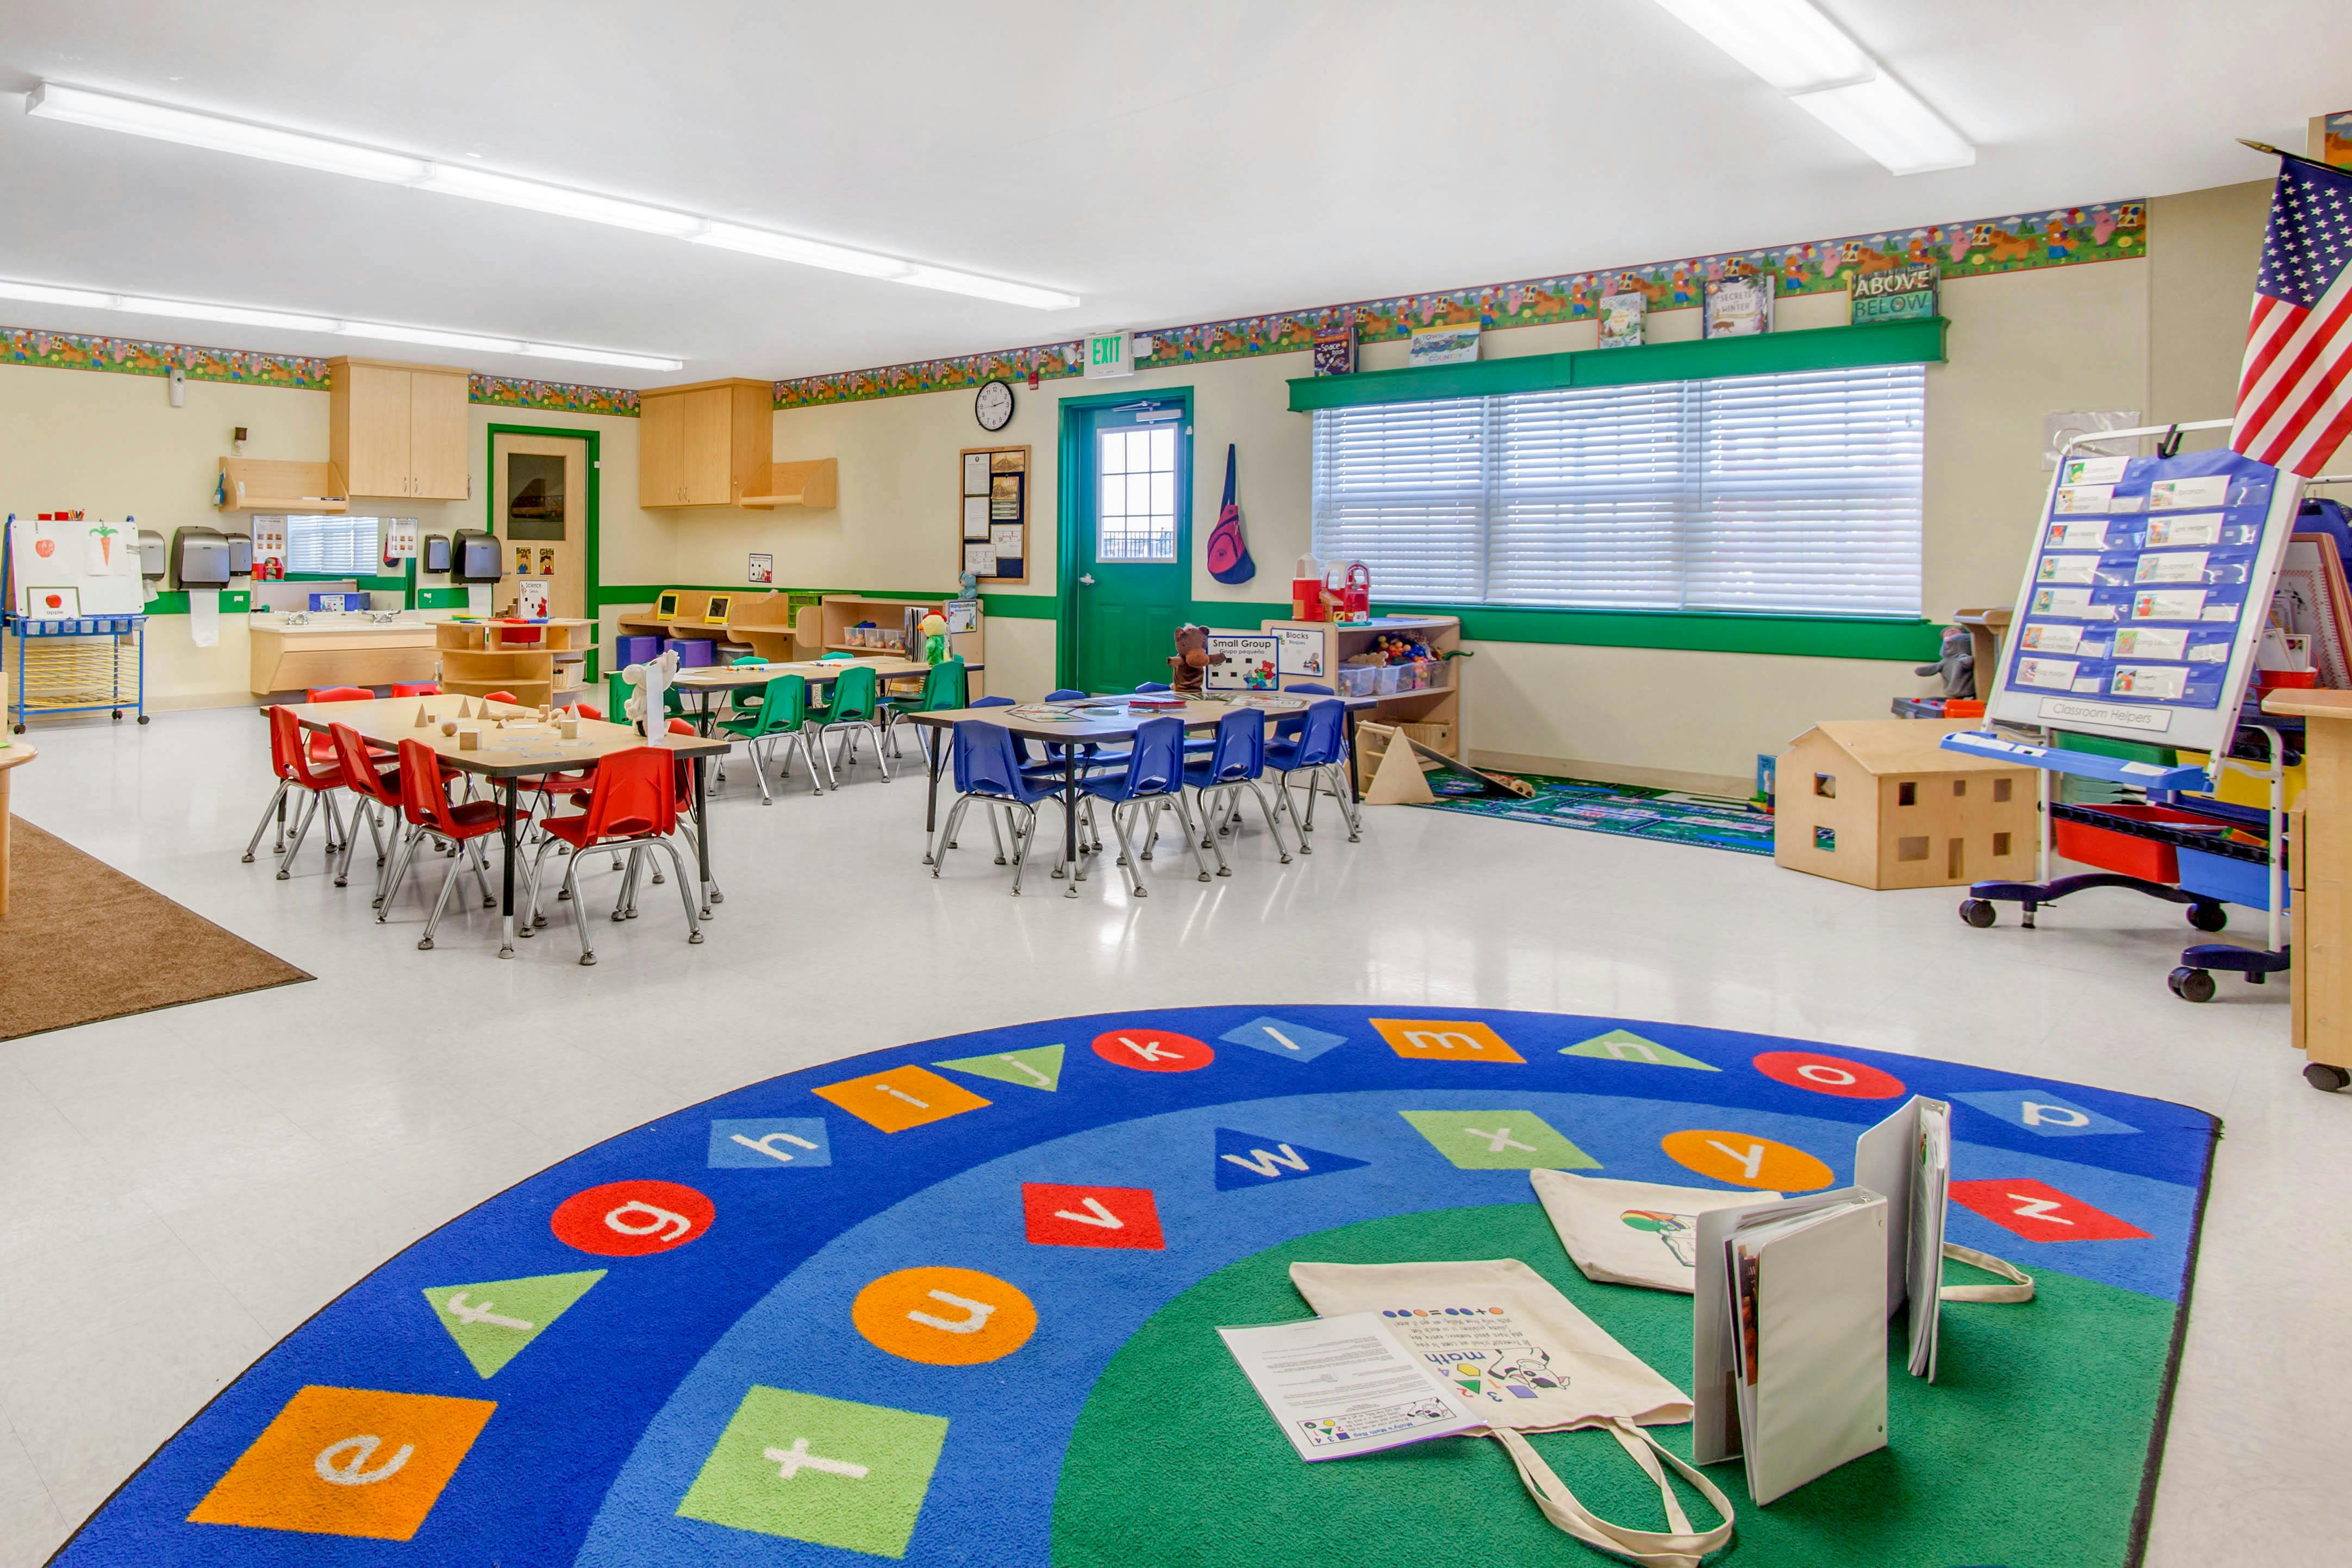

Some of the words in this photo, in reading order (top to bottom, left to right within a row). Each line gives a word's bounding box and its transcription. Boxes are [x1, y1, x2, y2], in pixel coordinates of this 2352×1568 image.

[1855, 270, 1930, 297] ABOVE
[1720, 291, 1752, 302] SECRETS
[1721, 303, 1750, 313] WINTER
[1855, 293, 1927, 318] BELOW
[1093, 335, 1122, 365] EXIT
[1321, 343, 1341, 352] Space
[516, 547, 532, 555] Boys
[1213, 639, 1238, 648] Small
[1241, 639, 1271, 649] Group
[1286, 631, 1309, 639] Blocks
[2052, 703, 2107, 719] Classroom
[2110, 709, 2153, 724] Helpers
[1119, 1037, 1183, 1061] k
[1402, 1030, 1483, 1050] m
[1602, 1040, 1659, 1063] n
[999, 1054, 1051, 1087] j
[1798, 1065, 1856, 1085] o
[876, 1084, 929, 1108] i
[2022, 1101, 2090, 1128] p
[730, 1132, 819, 1162] h
[1464, 1127, 1538, 1153] x
[1221, 1144, 1309, 1178] w
[1706, 1140, 1764, 1178] y
[1054, 1197, 1124, 1229] v
[2007, 1192, 2074, 1225] z
[605, 1201, 691, 1241] g
[446, 1292, 534, 1330] f
[907, 1289, 996, 1333] u
[1424, 1351, 1487, 1365] math
[1438, 1367, 1449, 1377] 4
[1487, 1378, 1501, 1390] 1
[1457, 1387, 1474, 1398] 2
[1487, 1391, 1503, 1403] 3
[314, 1434, 415, 1486] e
[763, 1436, 870, 1479] t
